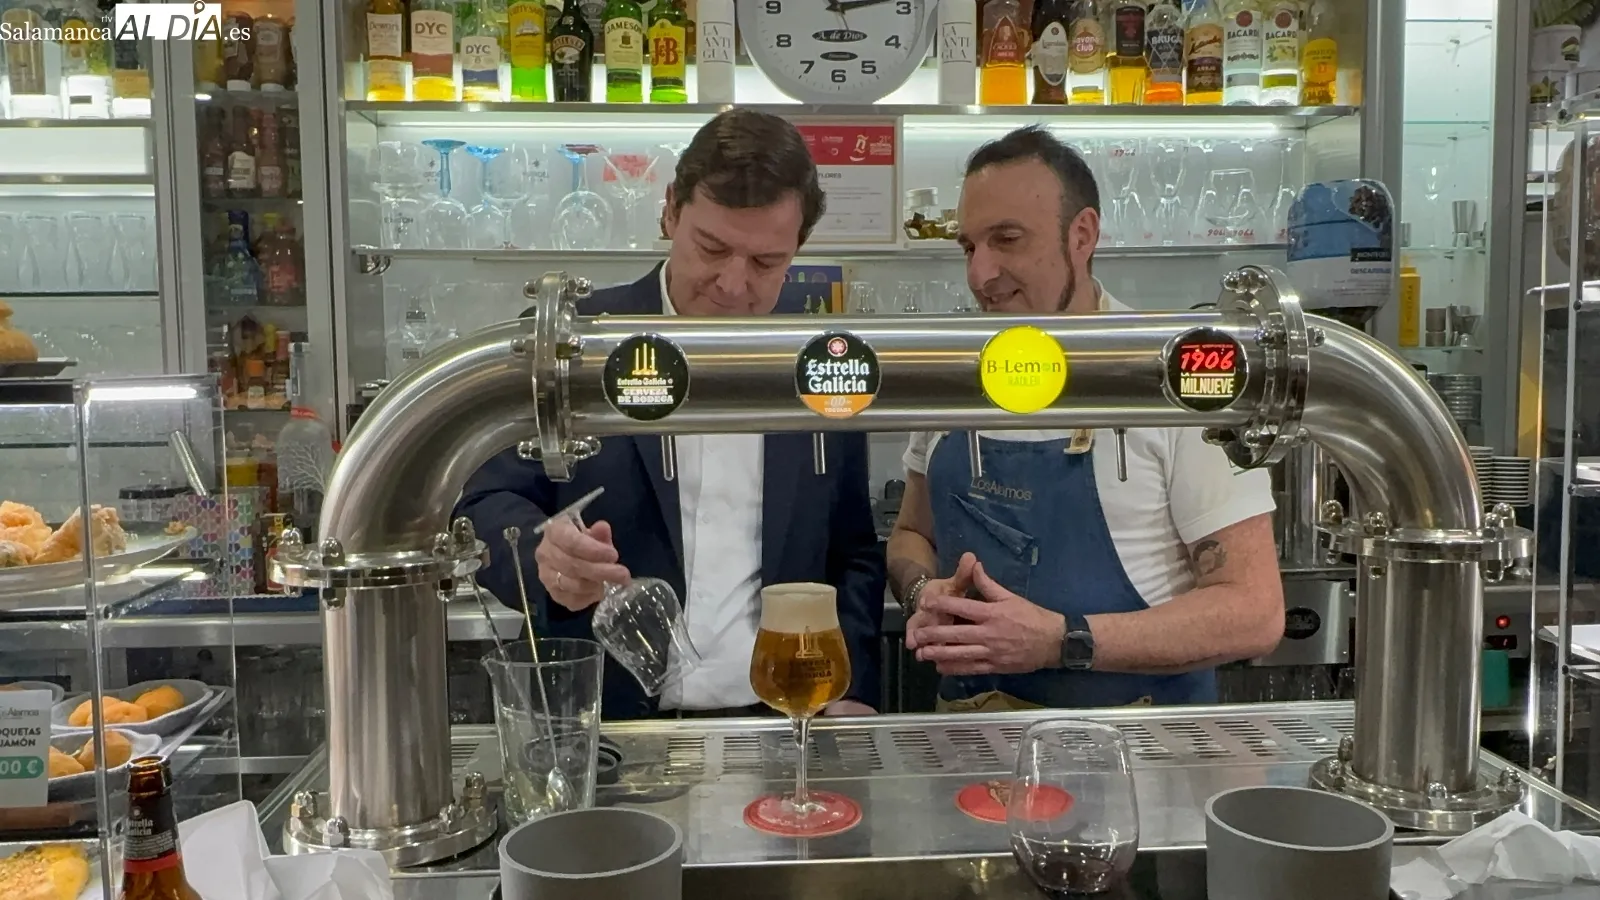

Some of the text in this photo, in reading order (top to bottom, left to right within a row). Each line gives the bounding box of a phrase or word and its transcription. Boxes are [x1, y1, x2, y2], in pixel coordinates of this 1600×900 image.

[766, 1, 781, 14] 9
[896, 2, 912, 15] 3
[415, 22, 448, 35] DYC
[606, 21, 642, 34] JAMESON
[703, 25, 719, 36] LA
[1228, 29, 1259, 39] BACARDI
[776, 34, 792, 48] 8
[844, 31, 864, 40] Dios
[884, 35, 901, 49] 4
[465, 44, 491, 54] DYC
[704, 37, 731, 48] ANTI
[943, 37, 970, 48] ANTI
[1076, 43, 1094, 52] Club
[800, 60, 815, 74] 7
[861, 60, 876, 74] 5
[831, 69, 846, 83] 6
[805, 358, 870, 376] Estrella
[987, 360, 1062, 373] B-Lemon
[1181, 350, 1234, 371] 1906
[808, 375, 868, 394] Galicia
[1181, 378, 1235, 394] MILNUEVE
[622, 388, 668, 396] CERVEZA
[617, 395, 674, 403] DE BODEGA
[0, 728, 41, 737] QUETAS
[27, 760, 38, 774] €
